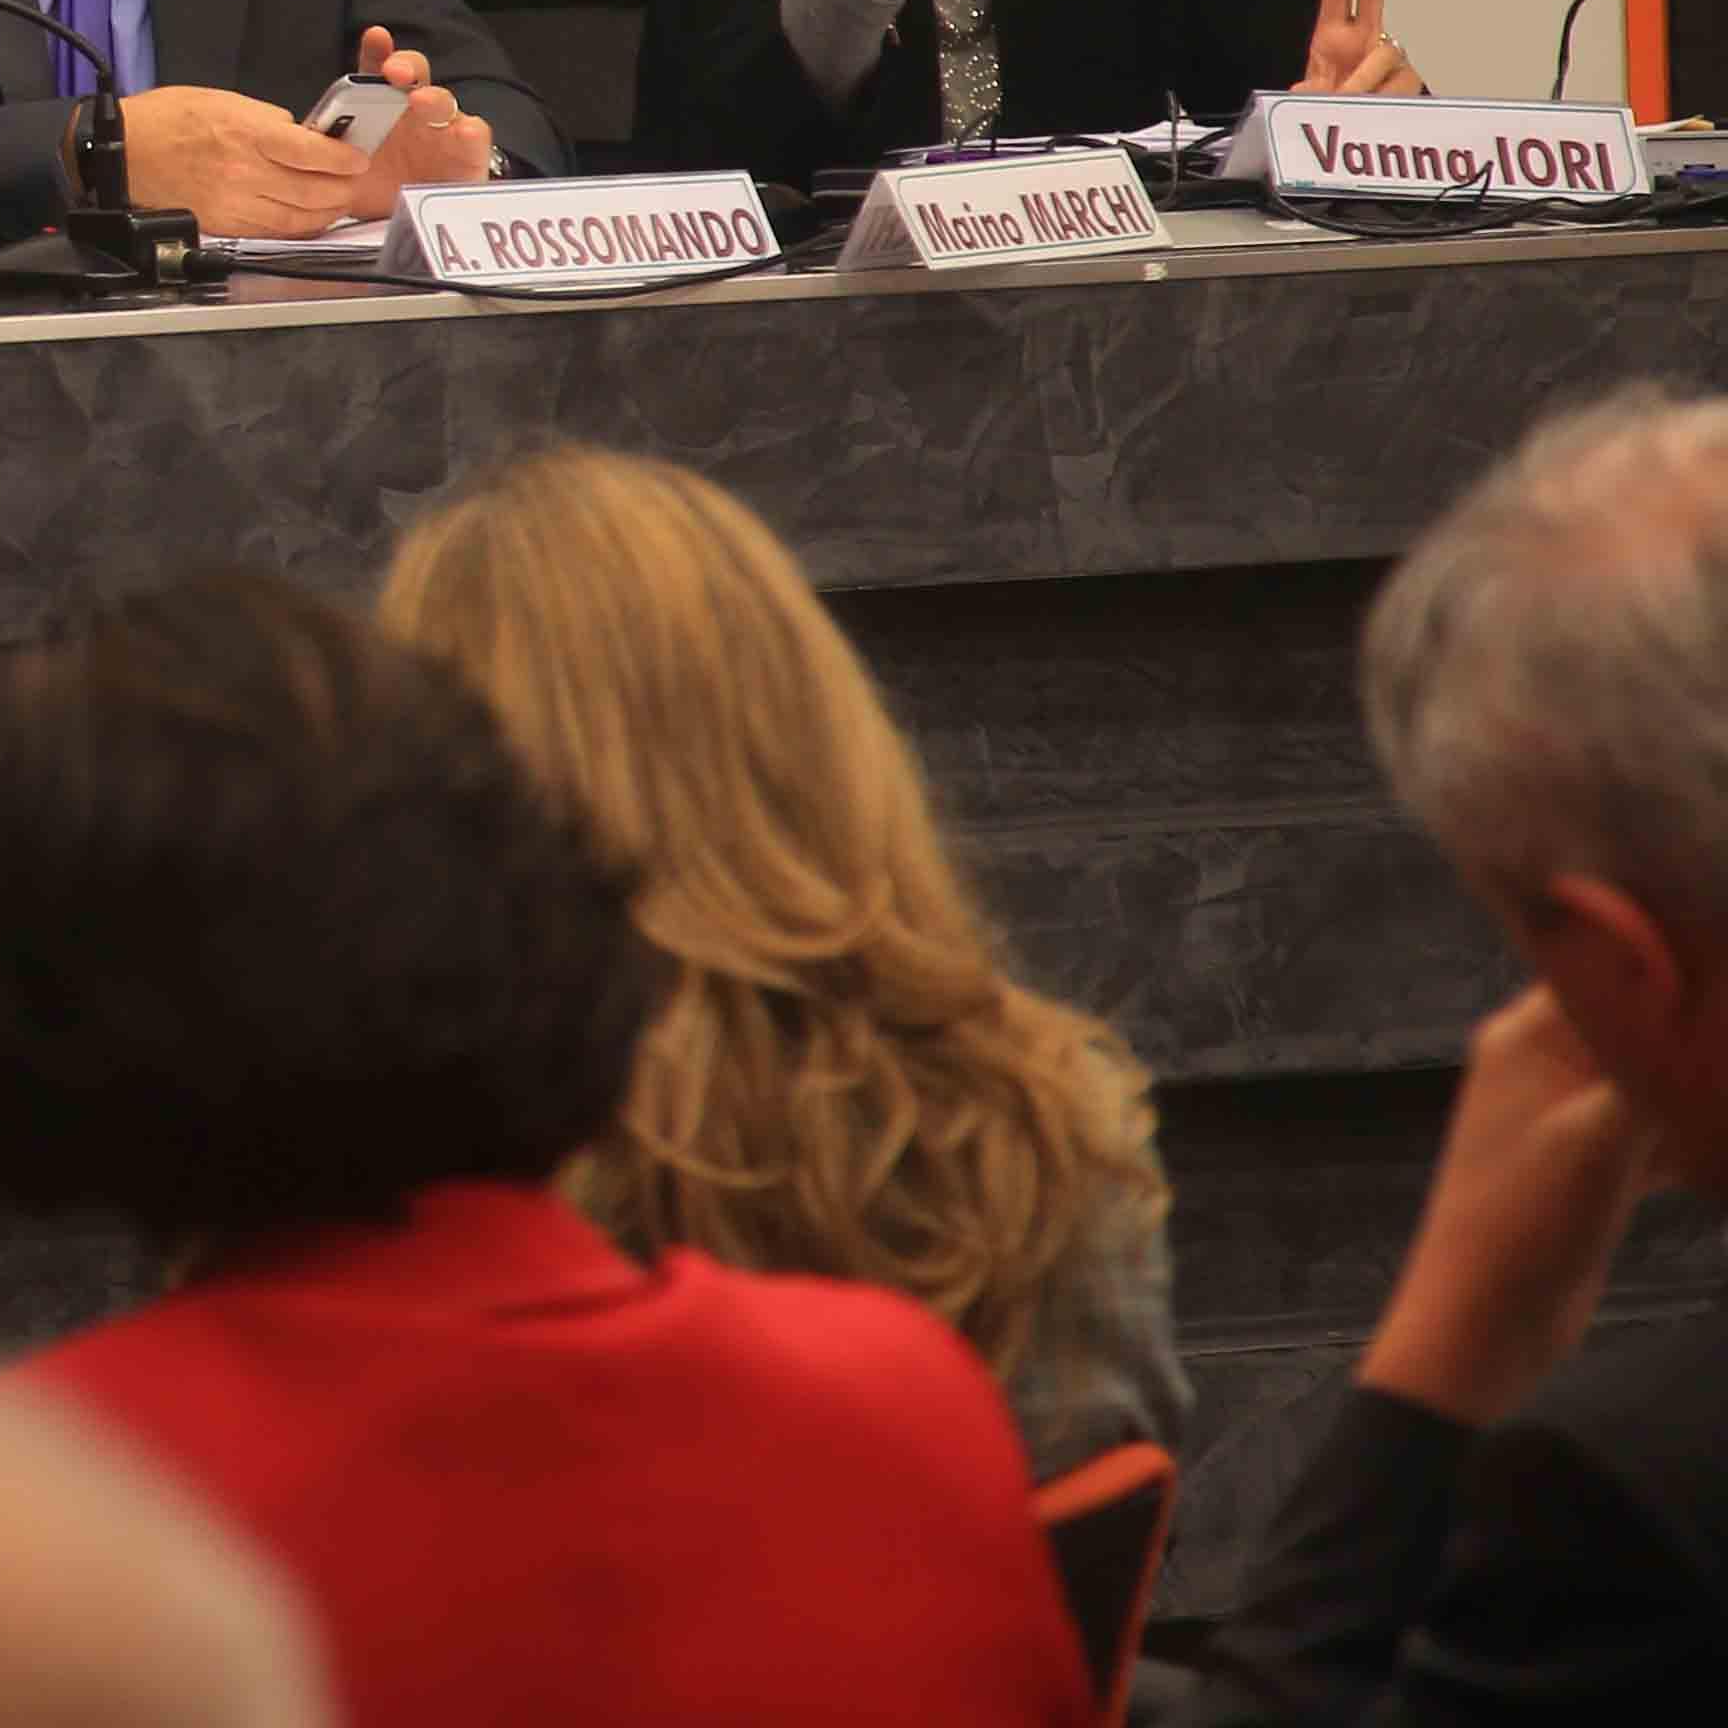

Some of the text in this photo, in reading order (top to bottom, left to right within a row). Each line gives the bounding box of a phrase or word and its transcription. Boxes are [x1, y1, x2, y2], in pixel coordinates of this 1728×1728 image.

[1300, 122, 1617, 192] Vanna IORI
[435, 208, 766, 273] A. ROSSOMANDO
[915, 184, 1152, 253] Maino MARCHI
